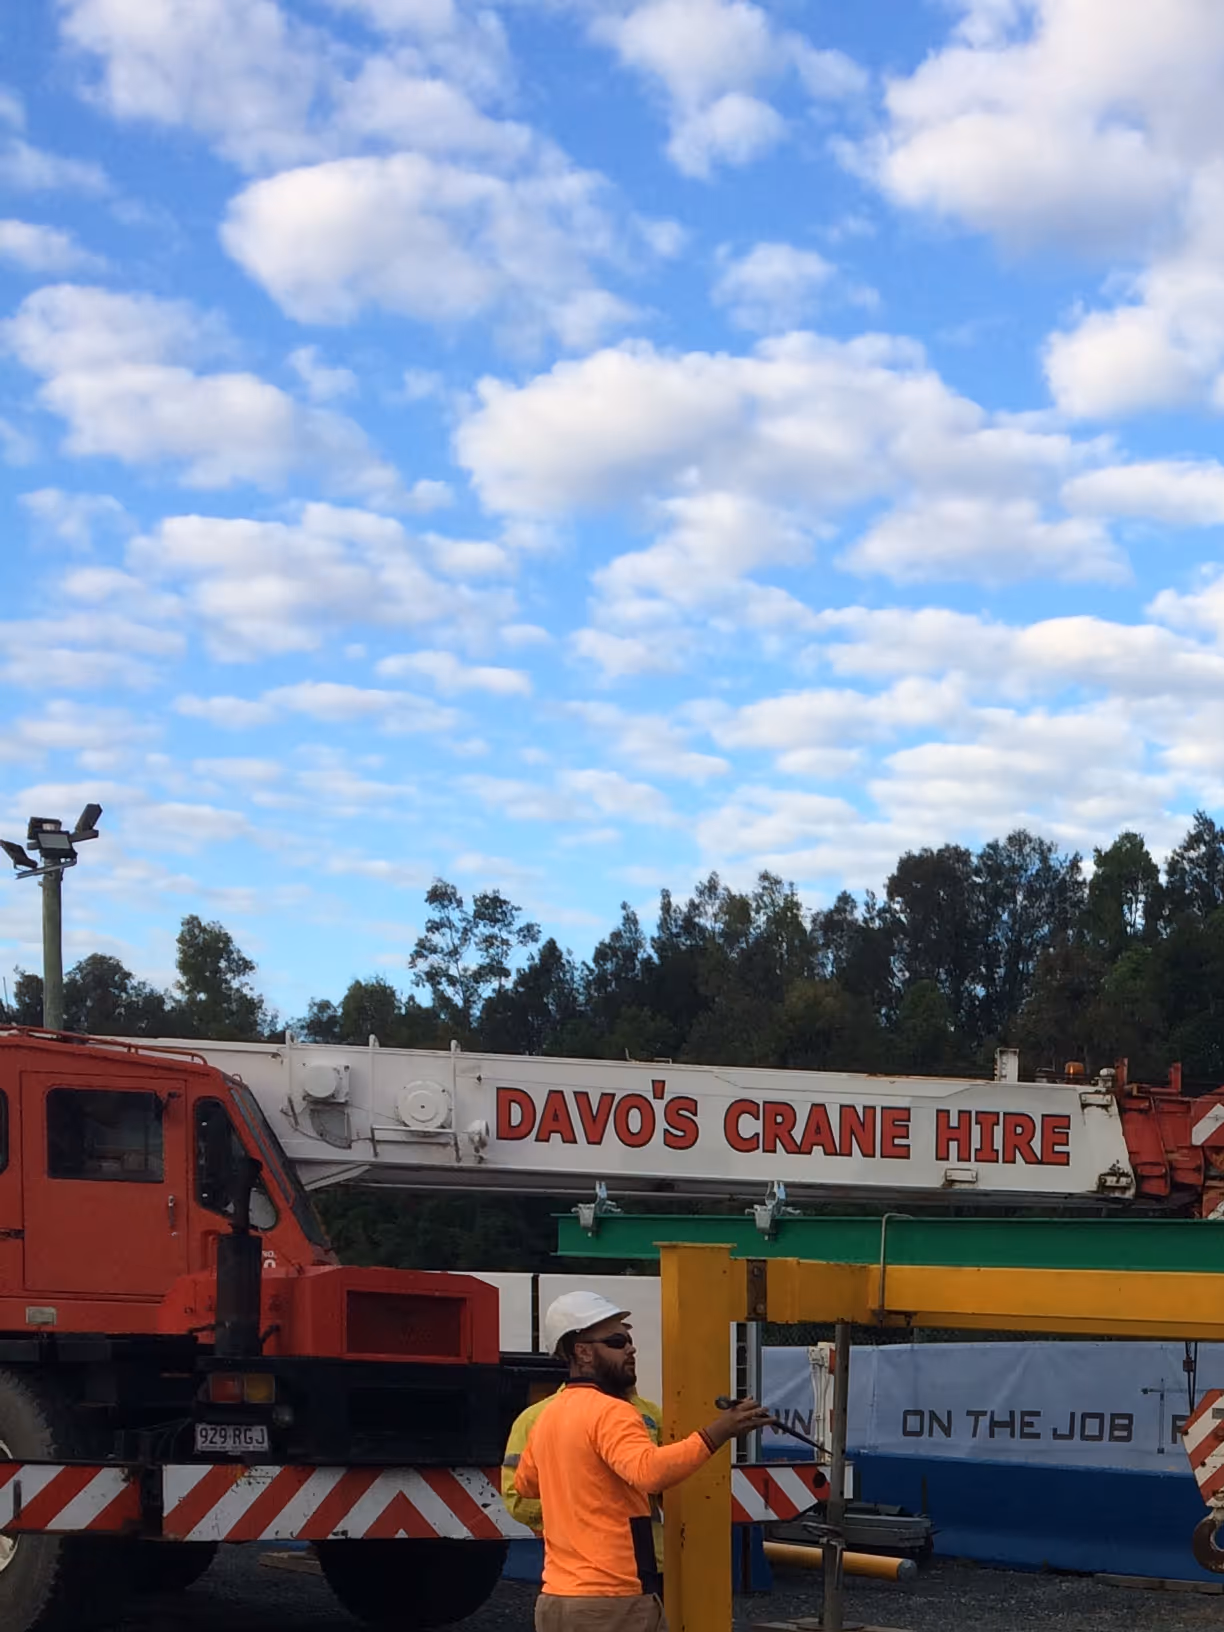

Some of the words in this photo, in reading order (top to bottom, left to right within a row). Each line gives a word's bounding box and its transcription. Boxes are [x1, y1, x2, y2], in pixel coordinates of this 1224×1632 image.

[496, 1080, 699, 1150] DAVO'S
[724, 1099, 911, 1160] CRANE
[935, 1109, 1070, 1166] HIRE
[902, 1409, 953, 1438] ON
[966, 1410, 1042, 1439] THE
[1052, 1411, 1134, 1442] JOB
